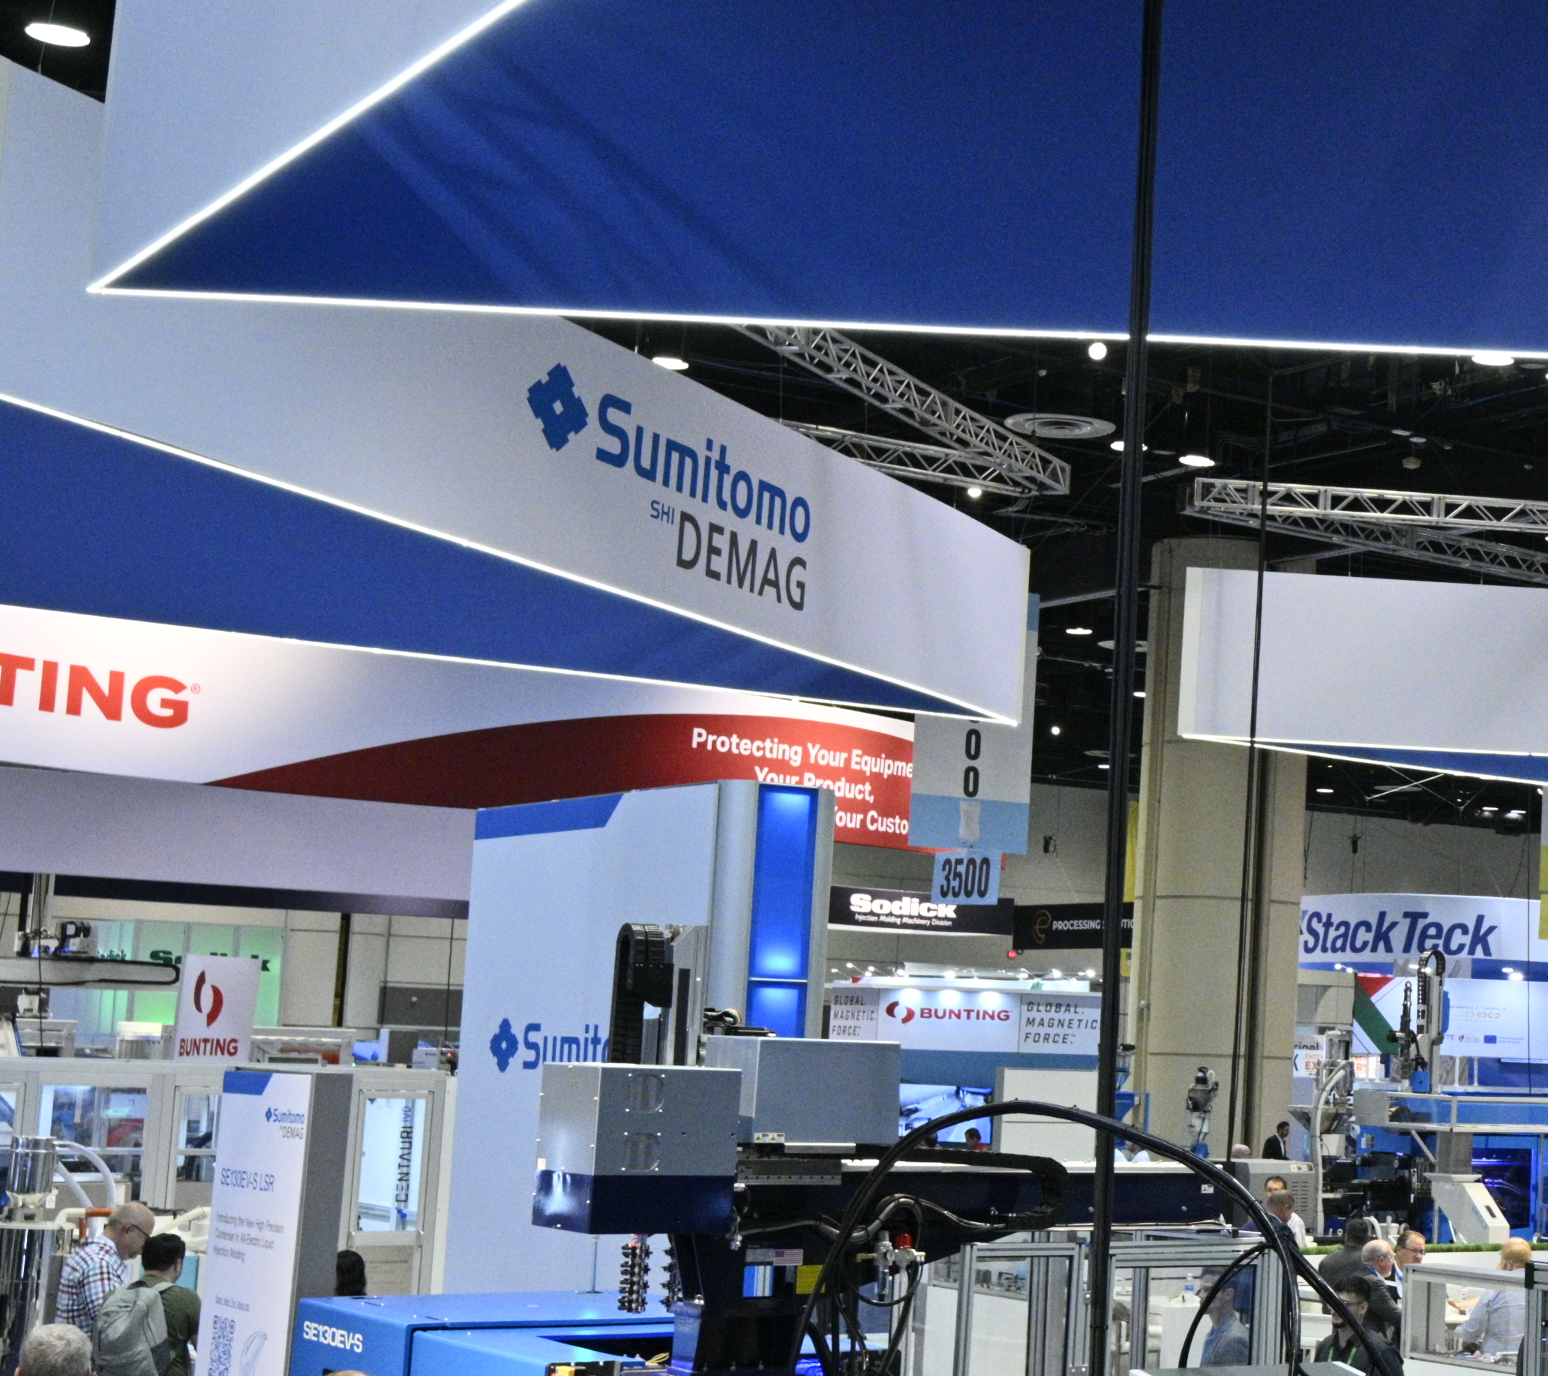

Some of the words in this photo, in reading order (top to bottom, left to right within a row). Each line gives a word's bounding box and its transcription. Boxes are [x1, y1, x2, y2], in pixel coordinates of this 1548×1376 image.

[595, 391, 812, 544] Sumitomo
[649, 498, 676, 527] SHI
[675, 508, 808, 613] DEMAG
[691, 727, 803, 767] Protecting
[807, 743, 848, 768] Your
[851, 749, 913, 779] Equipme
[866, 811, 909, 834] Custo
[939, 857, 991, 898] 3500
[849, 893, 957, 918] Sodick
[1052, 920, 1101, 930] PROCESSING
[920, 1007, 1011, 1022] BUNTING
[1026, 1001, 1085, 1014] GLOBAL.
[179, 1038, 238, 1057] BUNTING
[273, 1107, 305, 1124] Sumitomo
[282, 1126, 304, 1139] DEMAG
[259, 1173, 275, 1192] LSR
[303, 1321, 363, 1353] SE130EV-S
